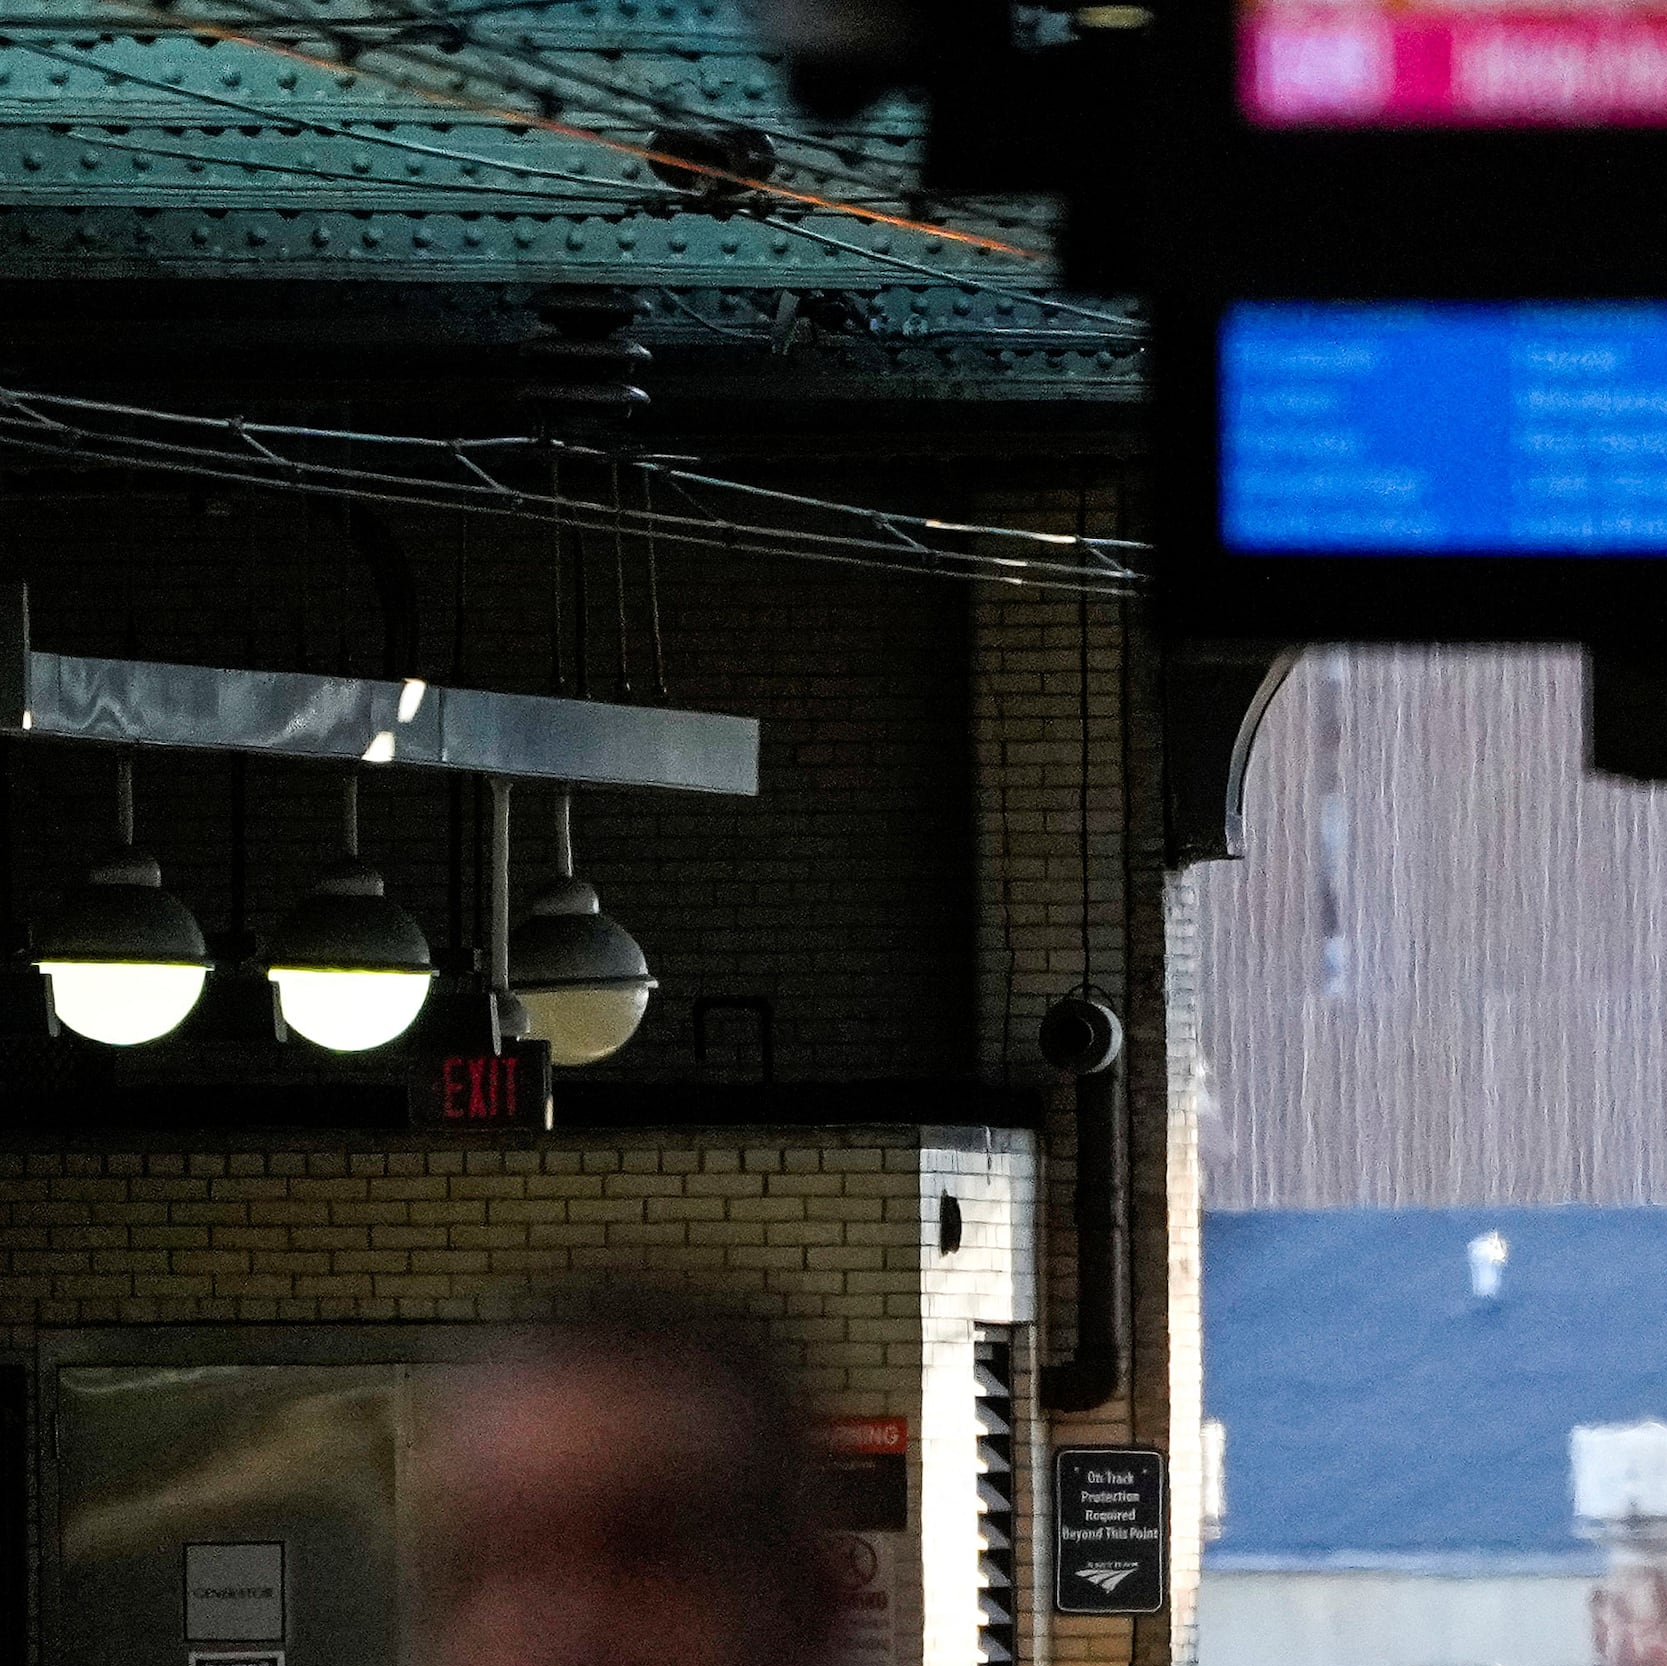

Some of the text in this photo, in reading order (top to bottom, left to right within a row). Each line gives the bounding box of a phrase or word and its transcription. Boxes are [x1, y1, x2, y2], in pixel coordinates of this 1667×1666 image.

[441, 1057, 519, 1118] EXIT
[1080, 1490, 1141, 1503] Protection
[1085, 1508, 1136, 1523] Required
[1062, 1525, 1104, 1543] Beyond
[1130, 1526, 1159, 1540] Point
